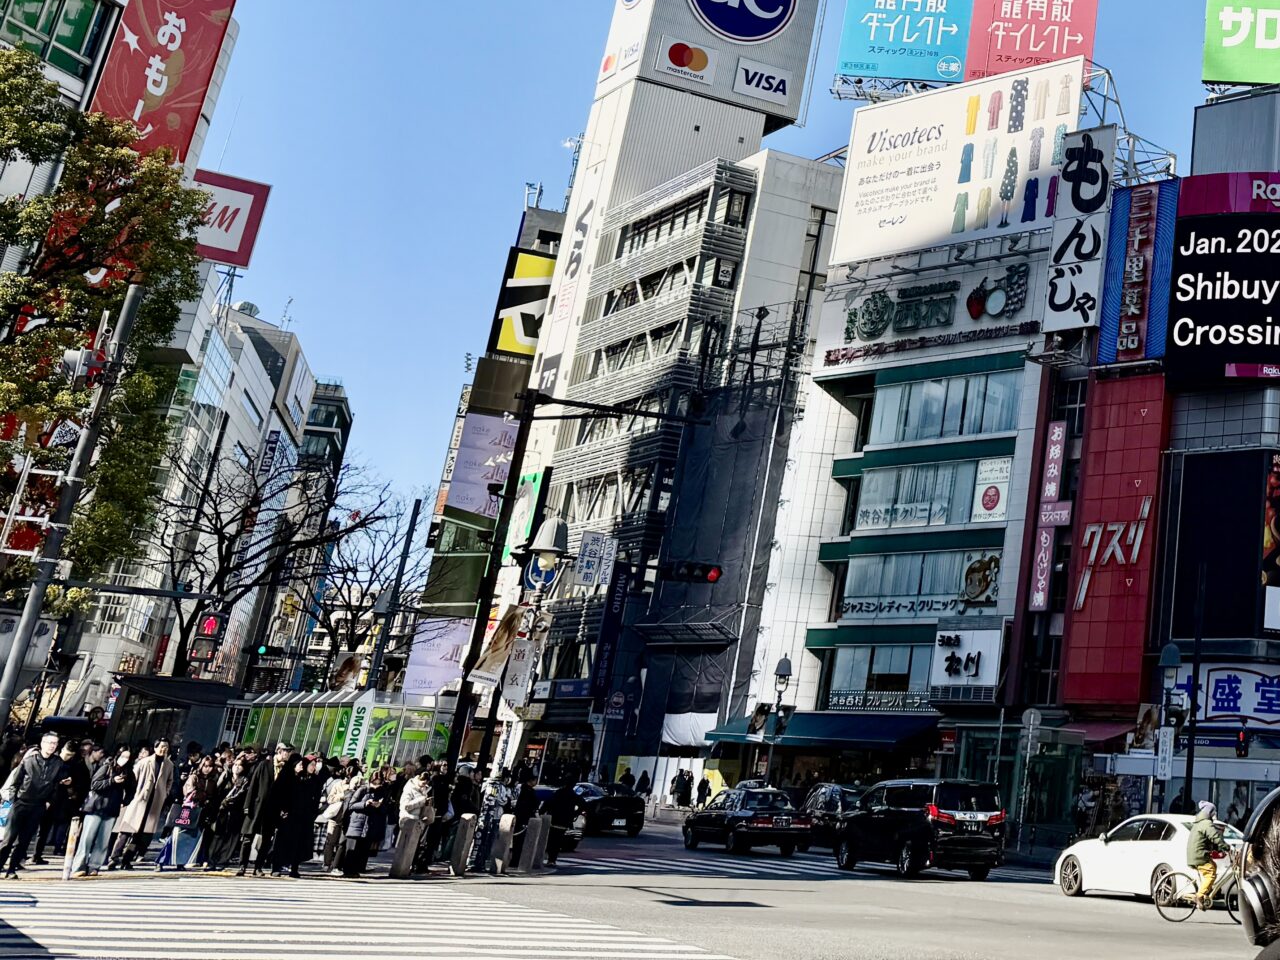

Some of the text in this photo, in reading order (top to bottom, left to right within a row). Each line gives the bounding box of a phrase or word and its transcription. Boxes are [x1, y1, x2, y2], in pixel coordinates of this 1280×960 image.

[861, 14, 959, 46] ダイレクト
[988, 21, 1084, 54] ダイレクト
[868, 45, 906, 56] スティック
[995, 54, 1033, 65] スティック
[666, 65, 704, 81] mastercard
[741, 67, 787, 96] VISA
[867, 124, 944, 154] Viscotecs
[1048, 134, 1109, 323] もんじゃ
[542, 367, 558, 390] 7F
[583, 536, 601, 583] 渋谷駅前
[612, 574, 627, 614] MIZUHO
[945, 651, 981, 677] 松川
